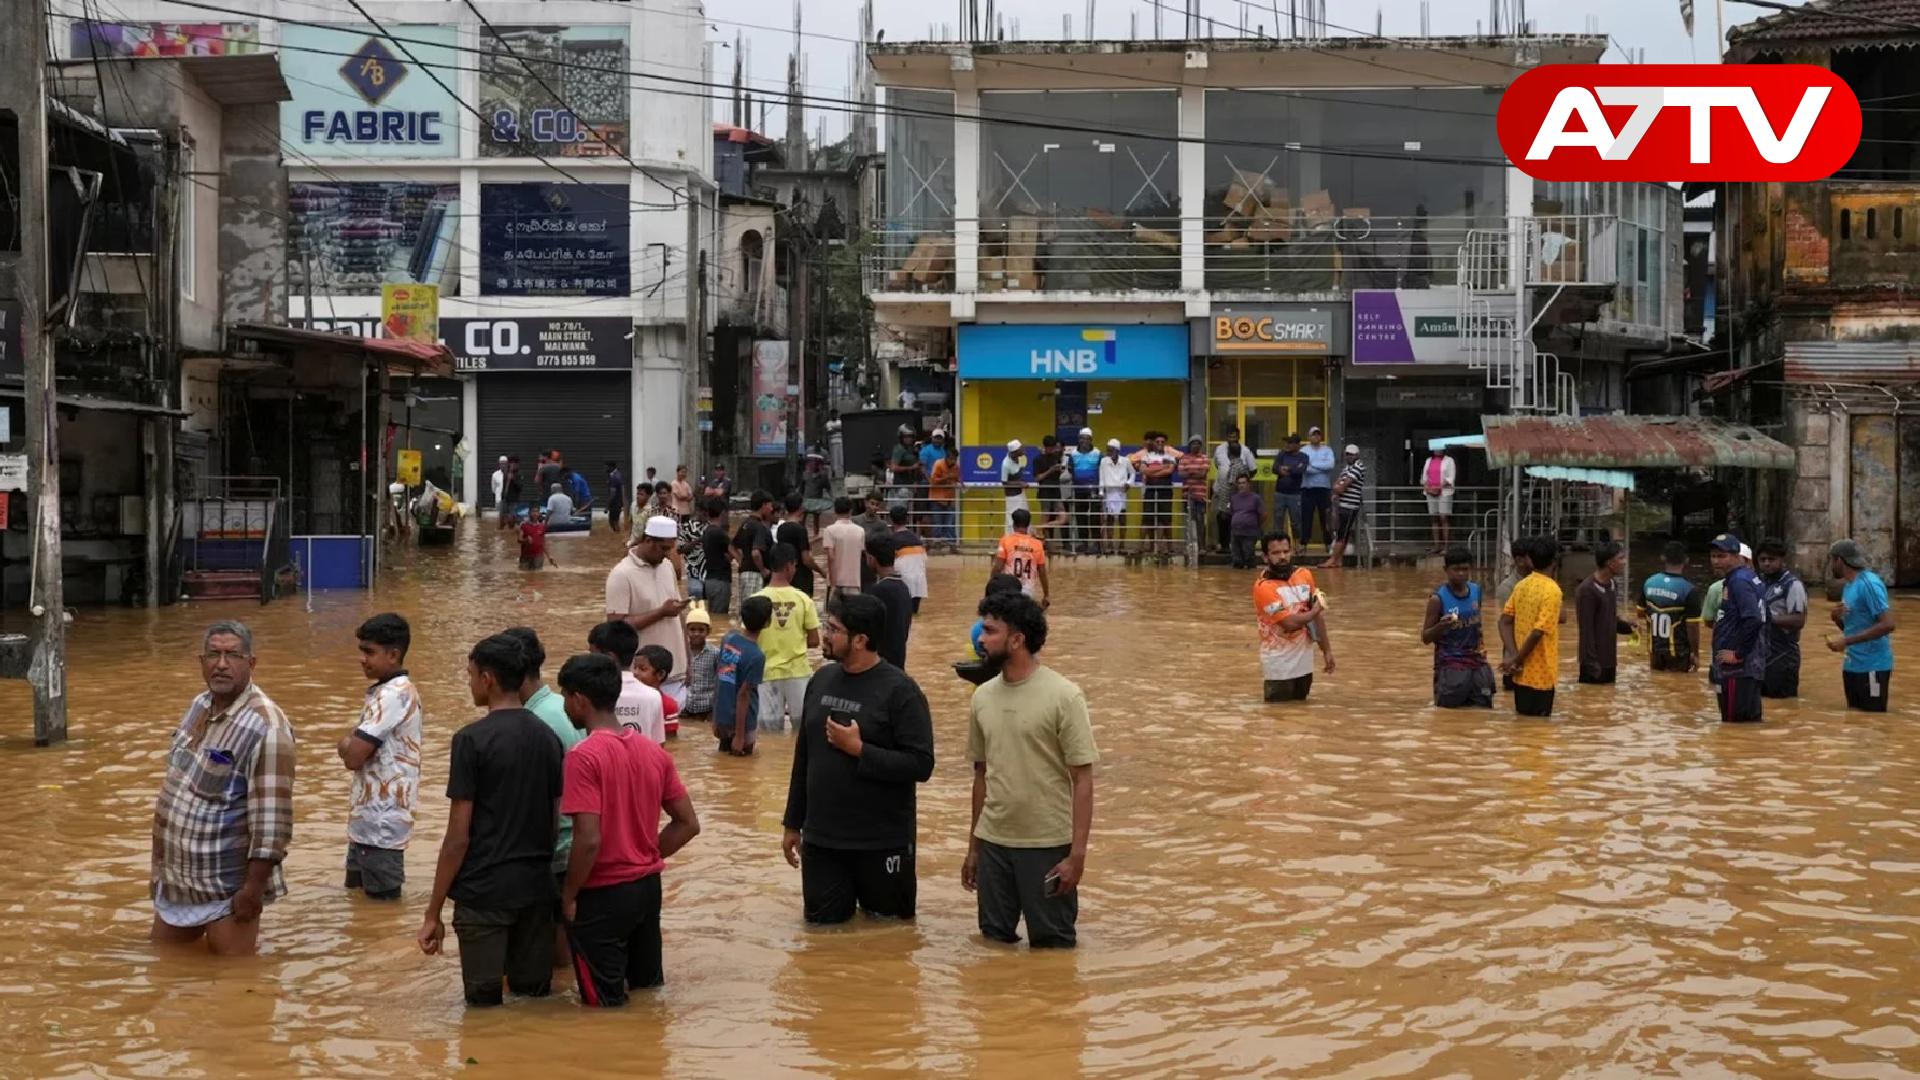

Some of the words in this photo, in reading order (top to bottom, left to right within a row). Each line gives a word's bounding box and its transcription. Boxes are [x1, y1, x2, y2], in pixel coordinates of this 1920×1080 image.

[304, 110, 441, 143] FABRIC
[493, 110, 519, 142] &
[532, 109, 588, 142] CO.
[465, 321, 531, 355] CO.
[539, 331, 562, 341] MAIN
[1216, 316, 1273, 340] BOC
[1274, 323, 1326, 340] SMART
[537, 355, 559, 366] 0775
[1031, 349, 1098, 374] HNB
[1014, 557, 1032, 579] 04
[1650, 613, 1671, 638] 10
[886, 855, 900, 874] 07
